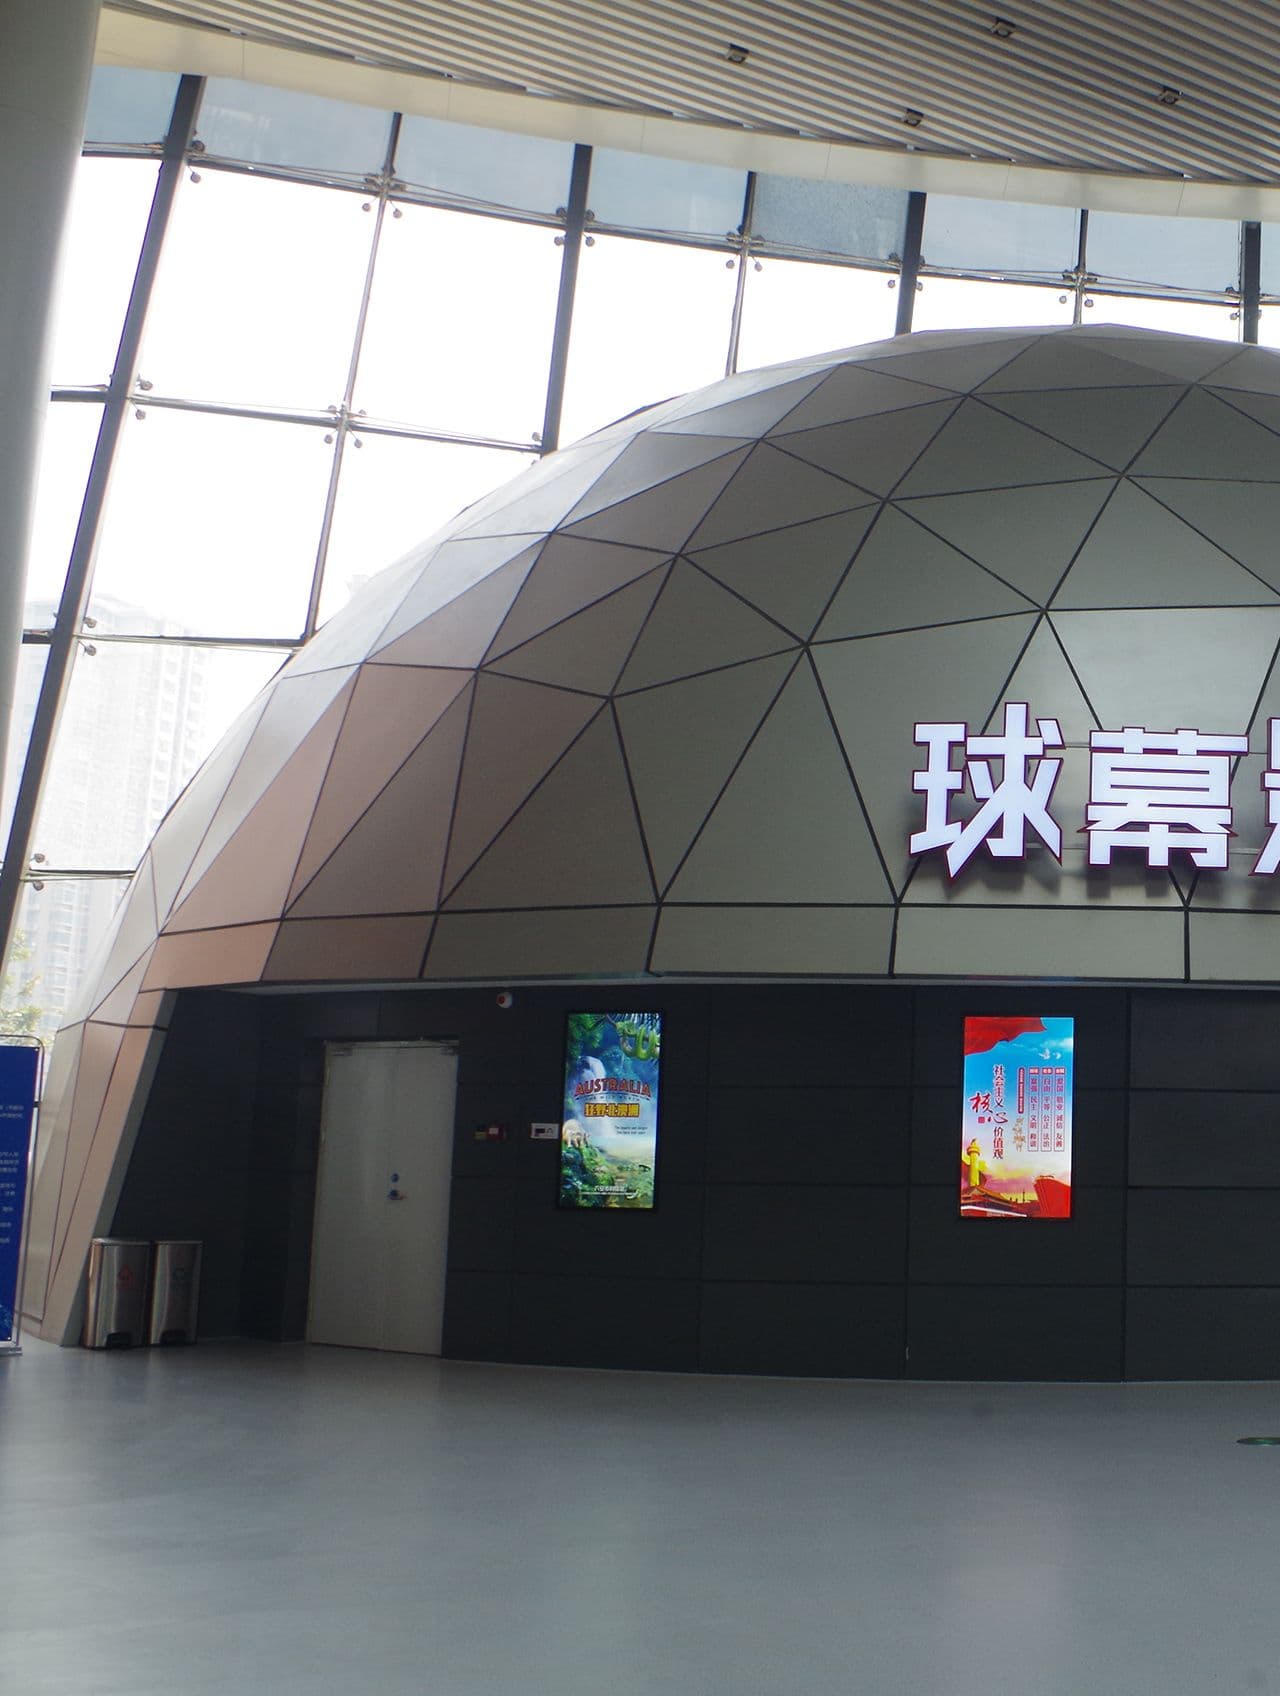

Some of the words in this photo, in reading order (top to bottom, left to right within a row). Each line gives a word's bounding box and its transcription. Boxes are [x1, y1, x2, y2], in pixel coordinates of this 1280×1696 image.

[574, 1077, 652, 1098] AUSTRALIA
[993, 1065, 1004, 1108] 社会主义
[993, 1126, 1004, 1159] 价值观
